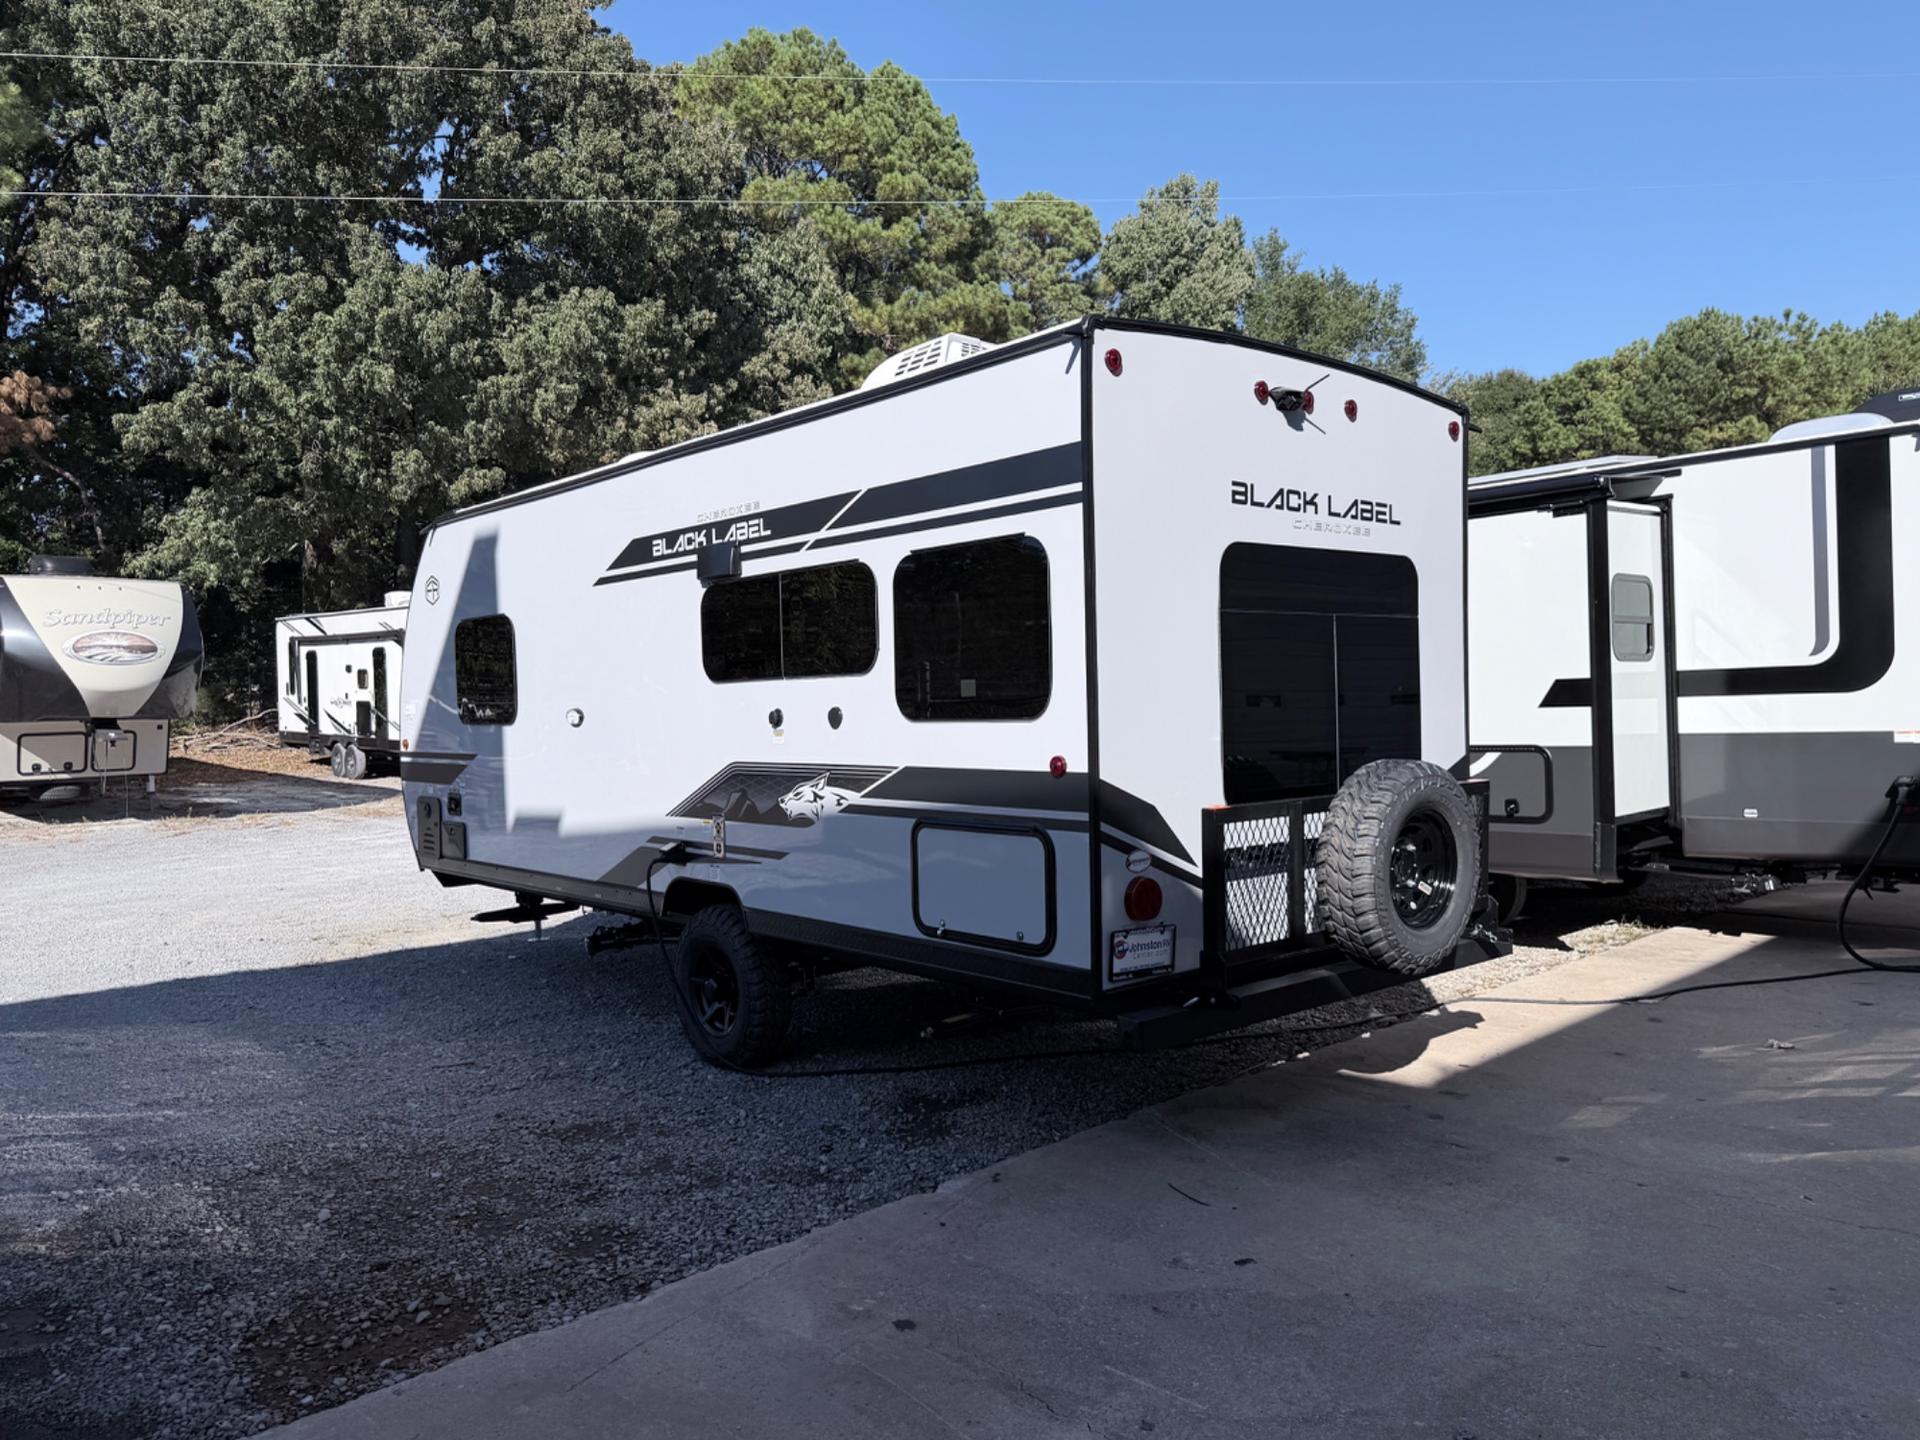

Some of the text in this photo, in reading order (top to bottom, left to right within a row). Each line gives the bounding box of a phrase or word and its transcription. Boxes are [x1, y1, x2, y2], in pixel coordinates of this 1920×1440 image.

[1231, 480, 1402, 526] BLACK LABEL
[652, 517, 772, 557] BLACK LABEL
[43, 607, 172, 630] Sandpiper
